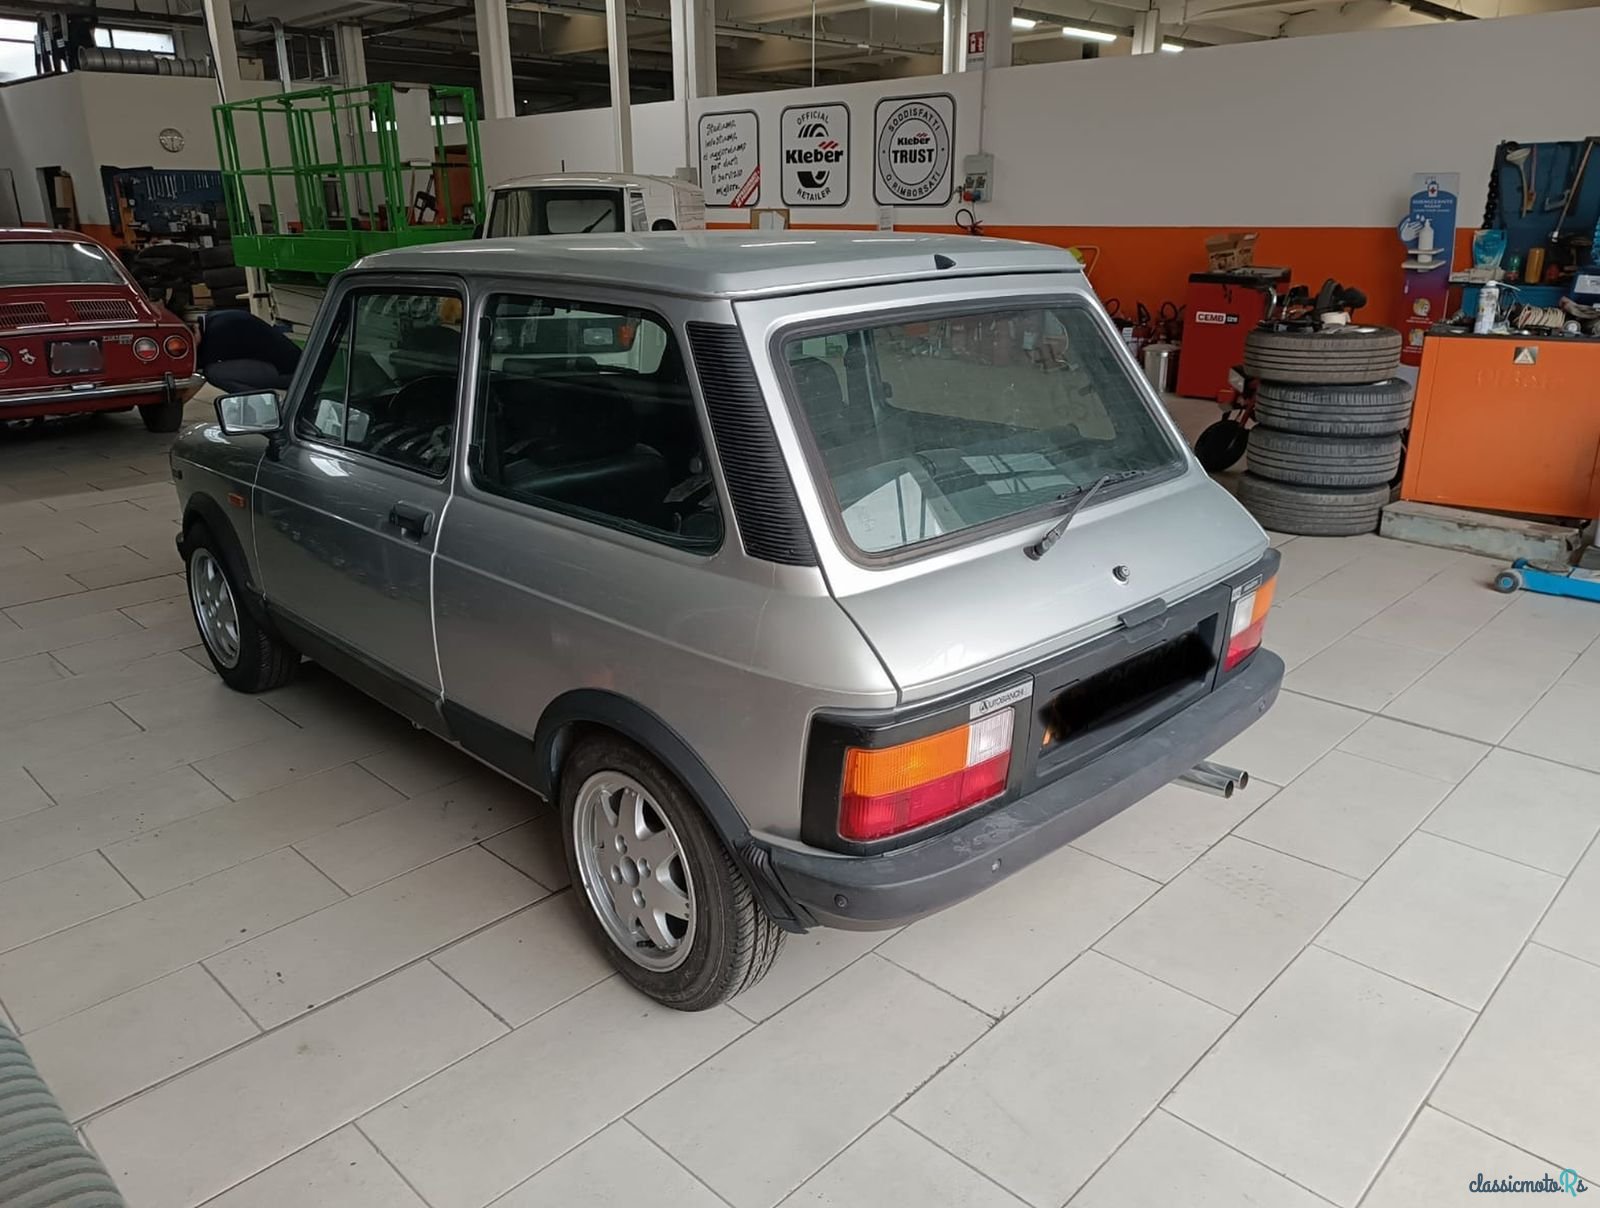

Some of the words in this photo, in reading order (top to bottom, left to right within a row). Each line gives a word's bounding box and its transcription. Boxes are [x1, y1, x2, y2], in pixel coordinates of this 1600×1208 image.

[796, 111, 829, 125] OFFICIAL
[888, 107, 940, 133] SODDISFATTI
[897, 136, 930, 146] Kleber
[785, 149, 844, 164] Kleber
[892, 148, 935, 164] TRUST
[885, 173, 892, 182] O
[892, 171, 941, 197] RIMBORSATI
[797, 187, 831, 201] RETAILER
[1197, 313, 1225, 323] CEMB
